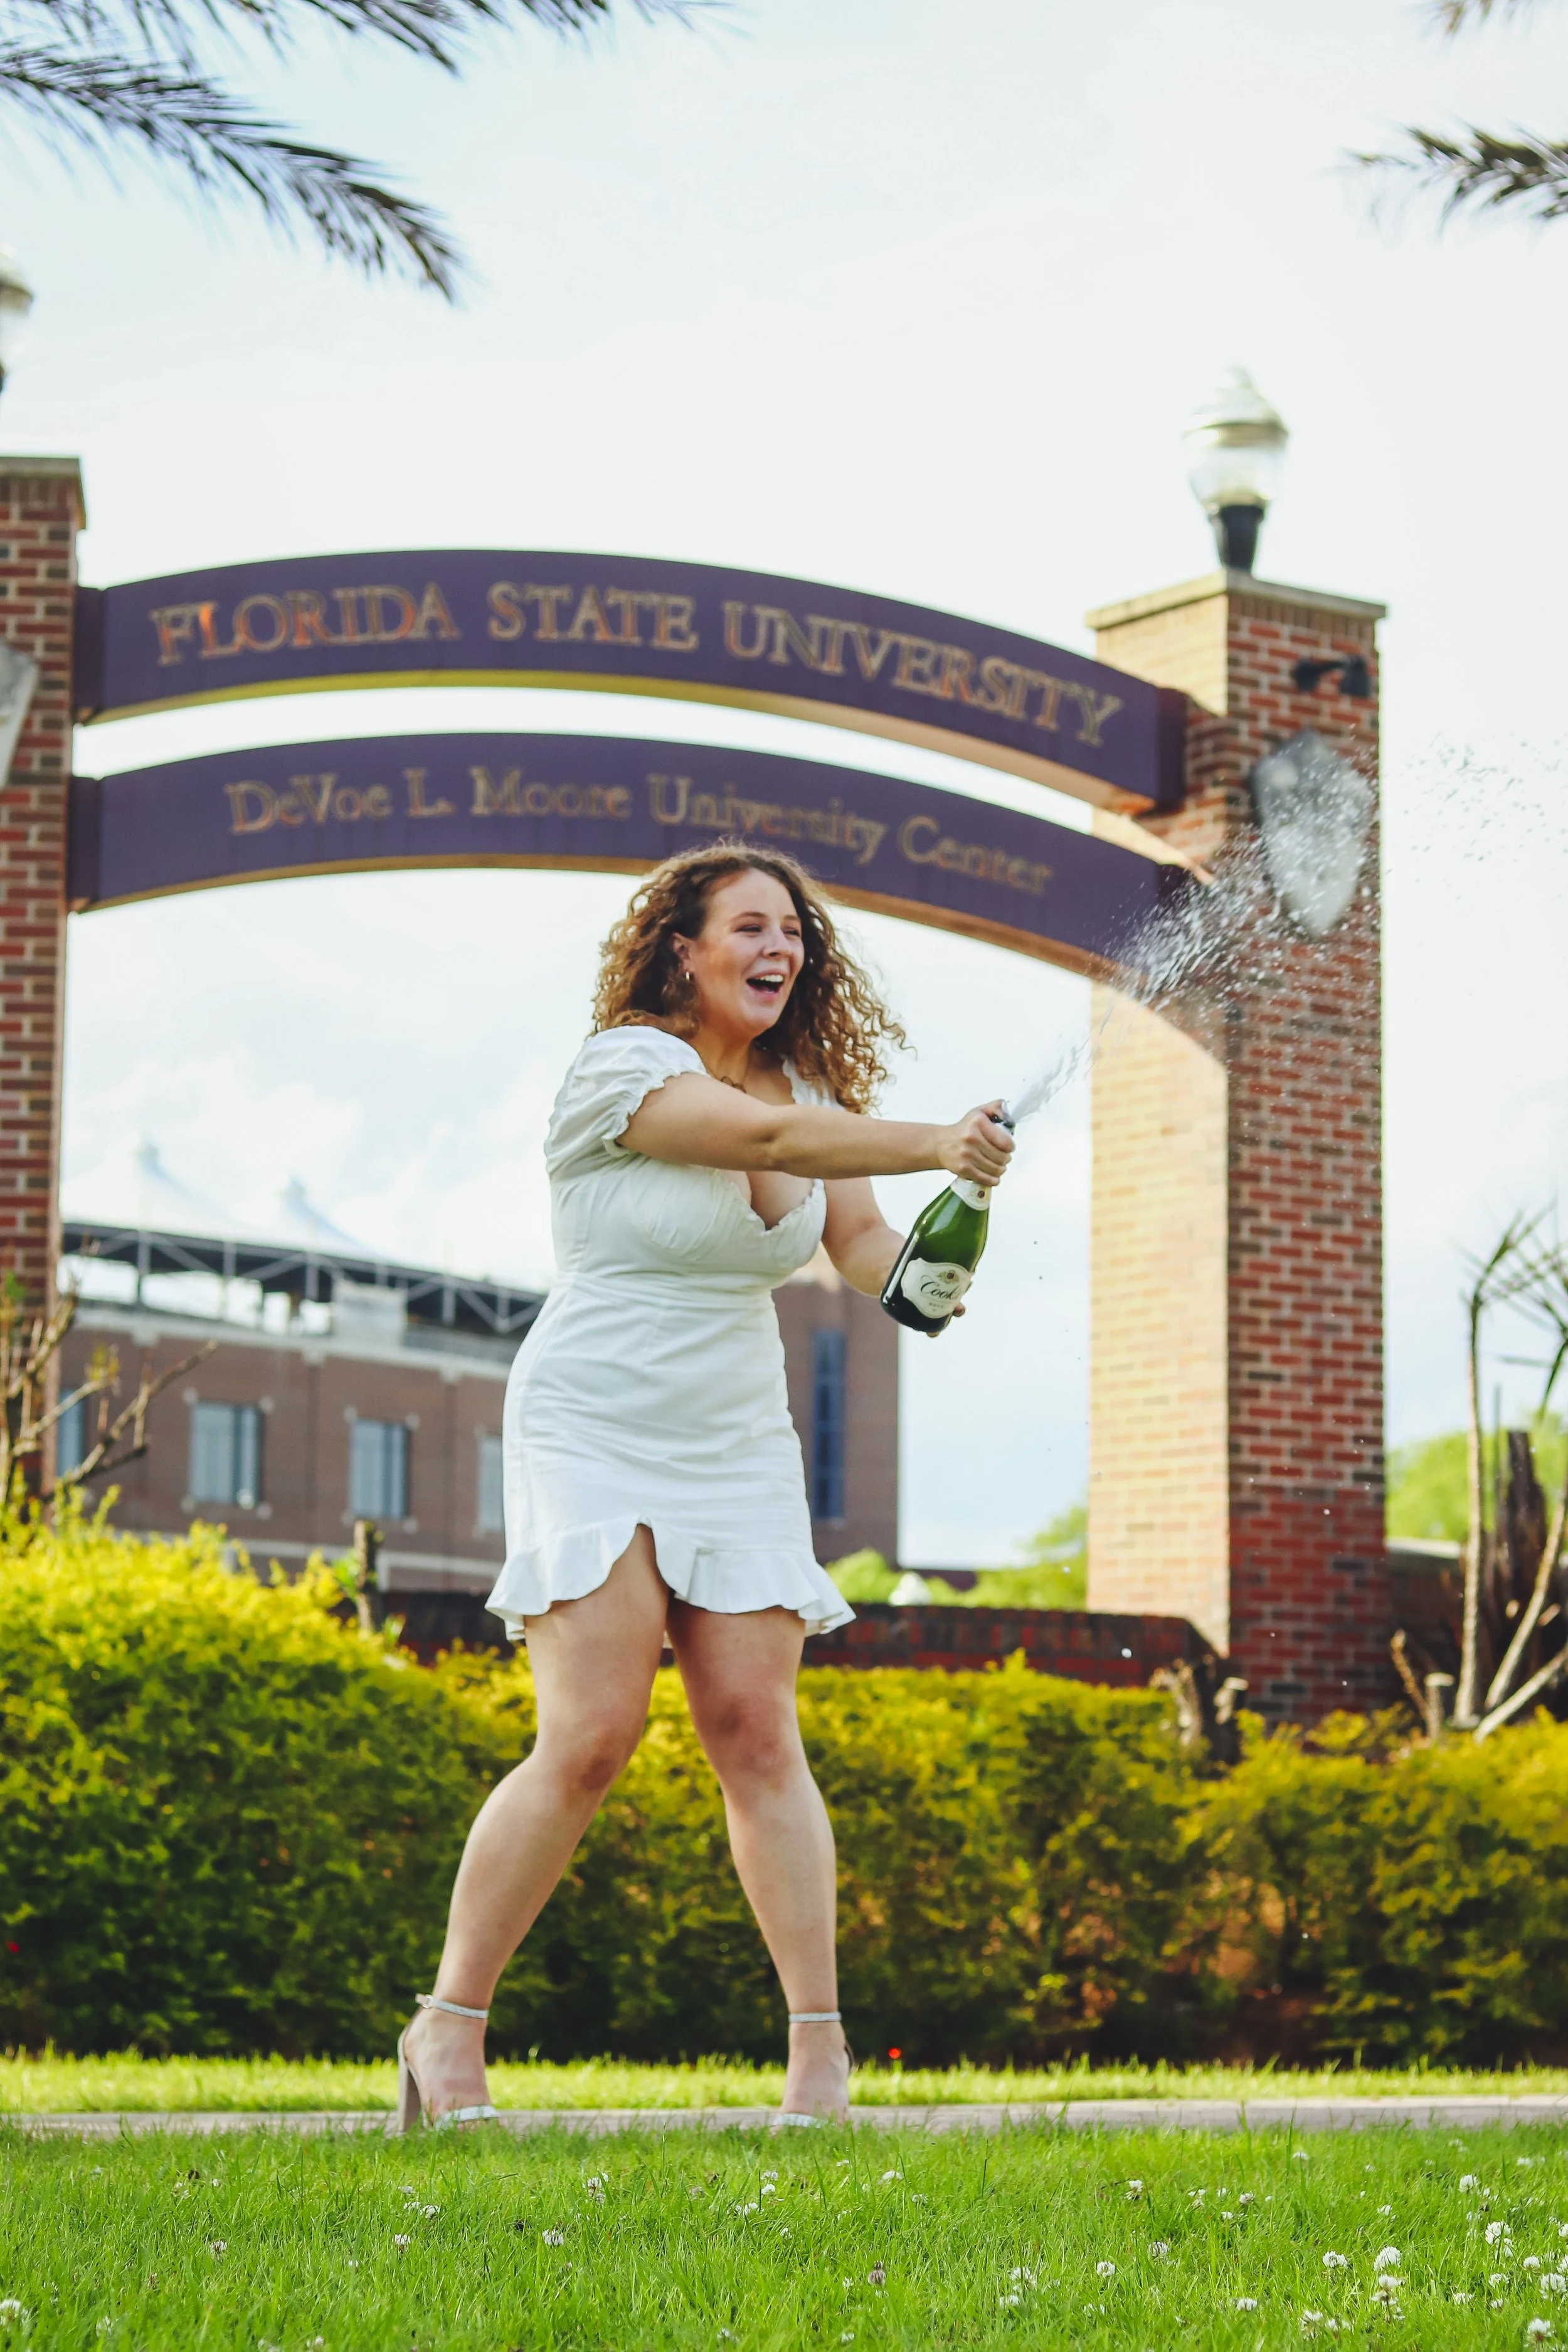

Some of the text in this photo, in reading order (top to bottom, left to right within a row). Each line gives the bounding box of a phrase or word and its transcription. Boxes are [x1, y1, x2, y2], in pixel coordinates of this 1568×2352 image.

[150, 581, 1123, 746] FLORIDA STATE UNIVERSITY
[225, 765, 1052, 896] DeVoe L. Moore University Center
